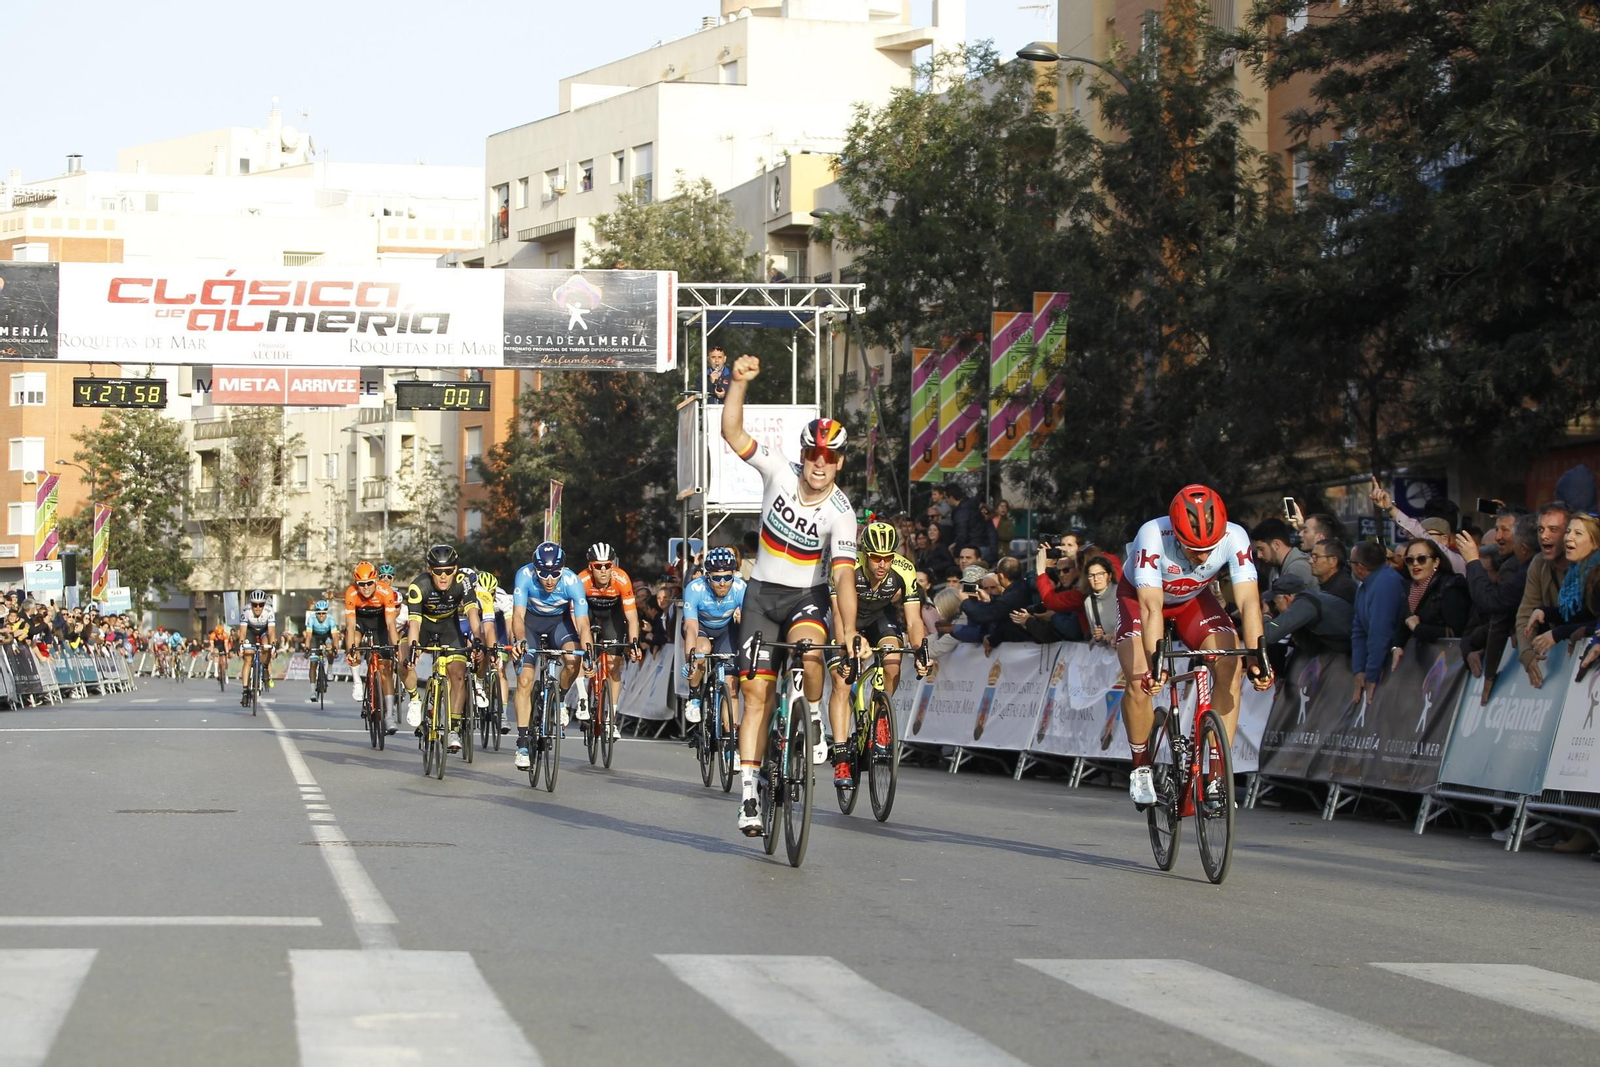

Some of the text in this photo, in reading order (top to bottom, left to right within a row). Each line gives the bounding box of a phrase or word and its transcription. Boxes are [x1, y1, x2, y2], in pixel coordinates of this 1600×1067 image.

[107, 269, 400, 308] CLÁSICA
[250, 351, 293, 360] ALCIDE
[219, 378, 281, 392] META
[834, 489, 850, 510] BORA
[772, 494, 819, 538] BORA
[769, 511, 817, 547] hansgrohe
[36, 563, 53, 572] 25
[1200, 614, 1221, 626] Alpecin
[1485, 683, 1553, 743] cajamar
